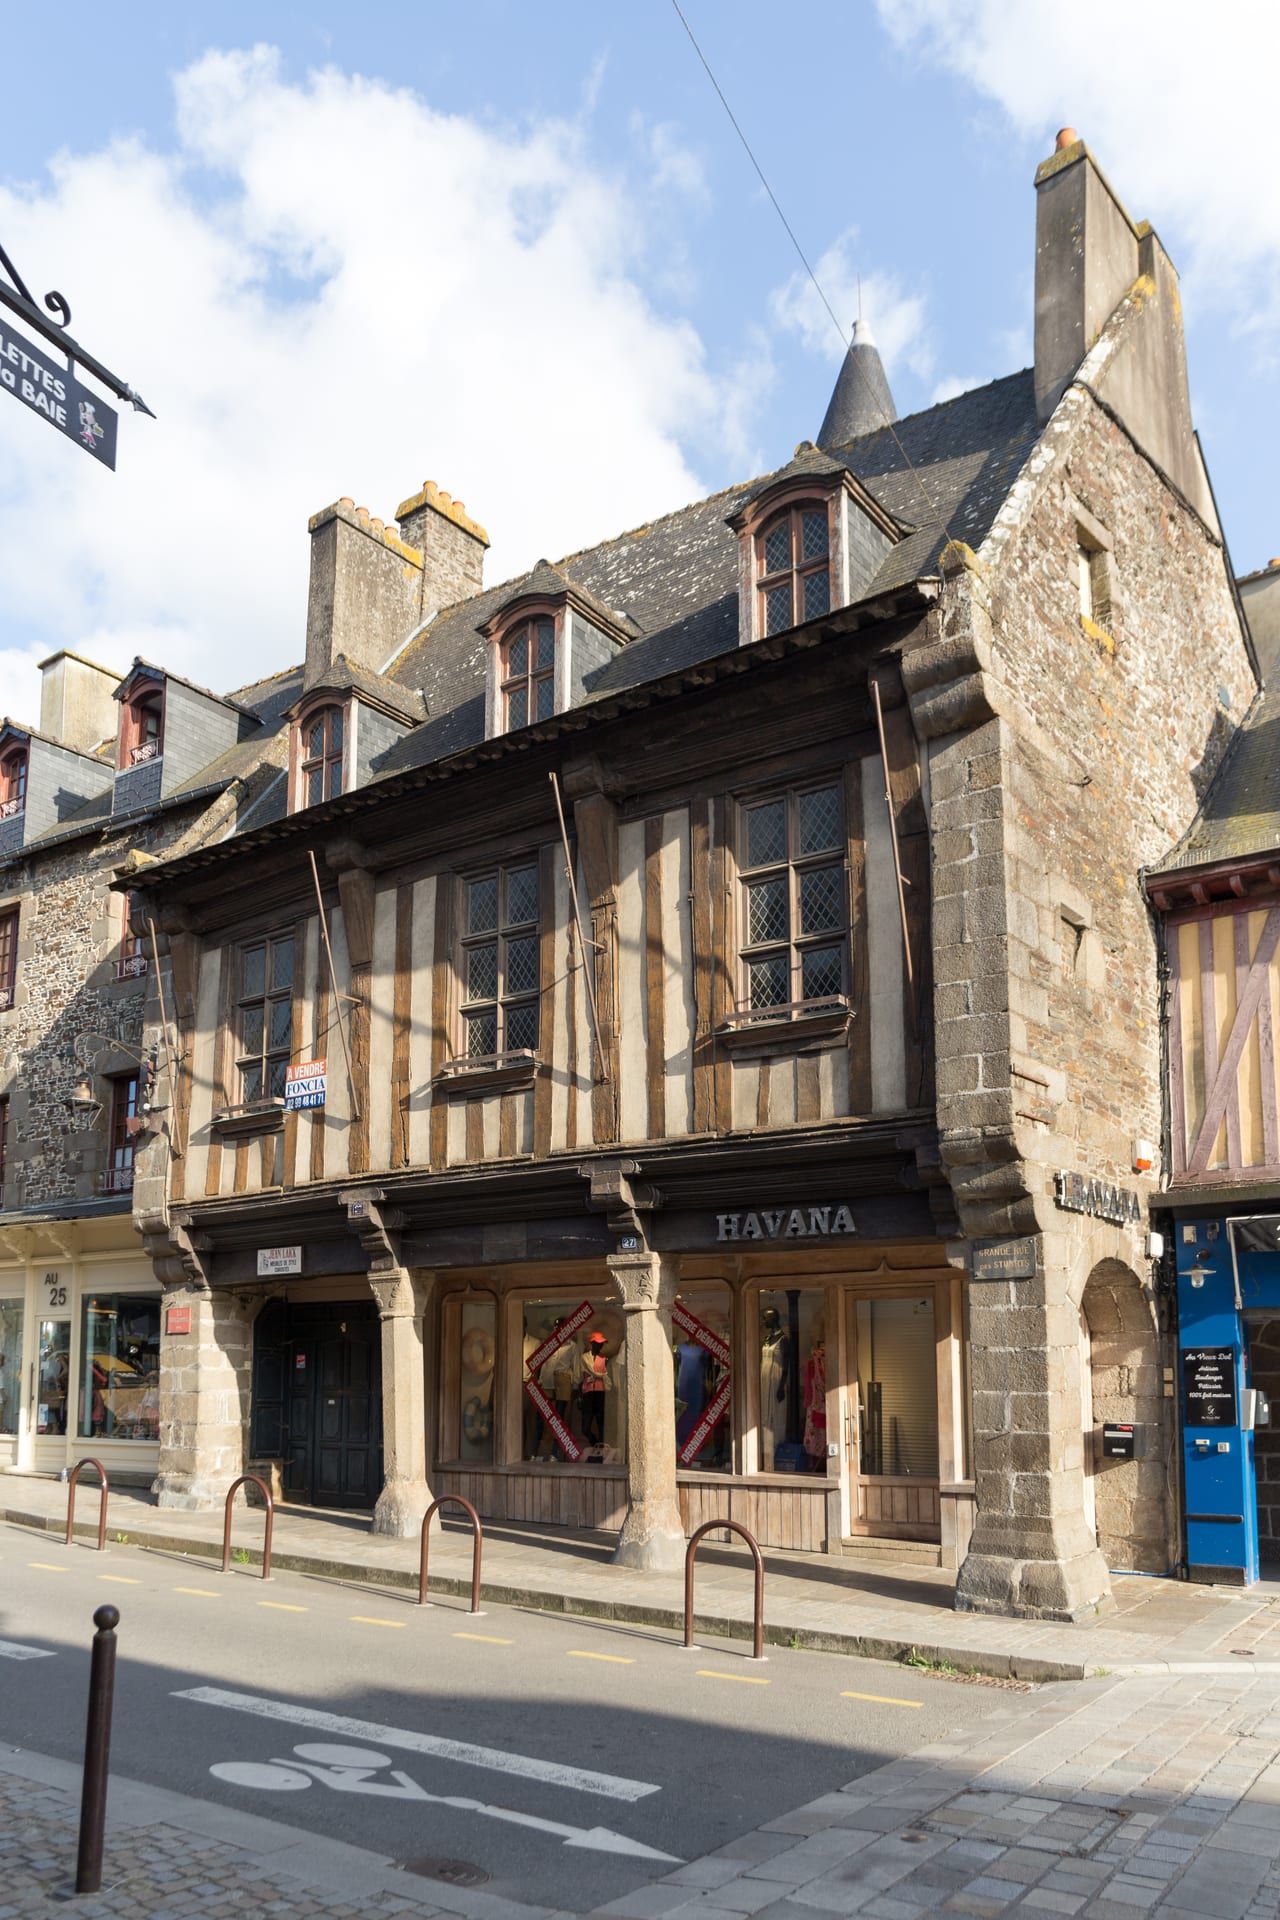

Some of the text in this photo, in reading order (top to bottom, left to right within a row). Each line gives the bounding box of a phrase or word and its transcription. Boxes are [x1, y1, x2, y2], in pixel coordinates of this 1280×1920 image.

[21, 378, 67, 427] BAIE
[294, 1061, 325, 1078] VENDRE
[287, 1077, 325, 1096] FONCIA
[716, 1205, 856, 1241] HAVANA
[623, 1238, 634, 1247] 27
[978, 1246, 1029, 1257] GRANDE RUE
[44, 1272, 58, 1285] AU
[50, 1287, 67, 1306] 25
[528, 1305, 593, 1369] DERNIÈRE DÉMARQUE
[1185, 1353, 1197, 1361] Au
[526, 1382, 580, 1460] DERNIÈRE DÉMARQUE
[681, 1422, 711, 1463] DERNIÈRE
